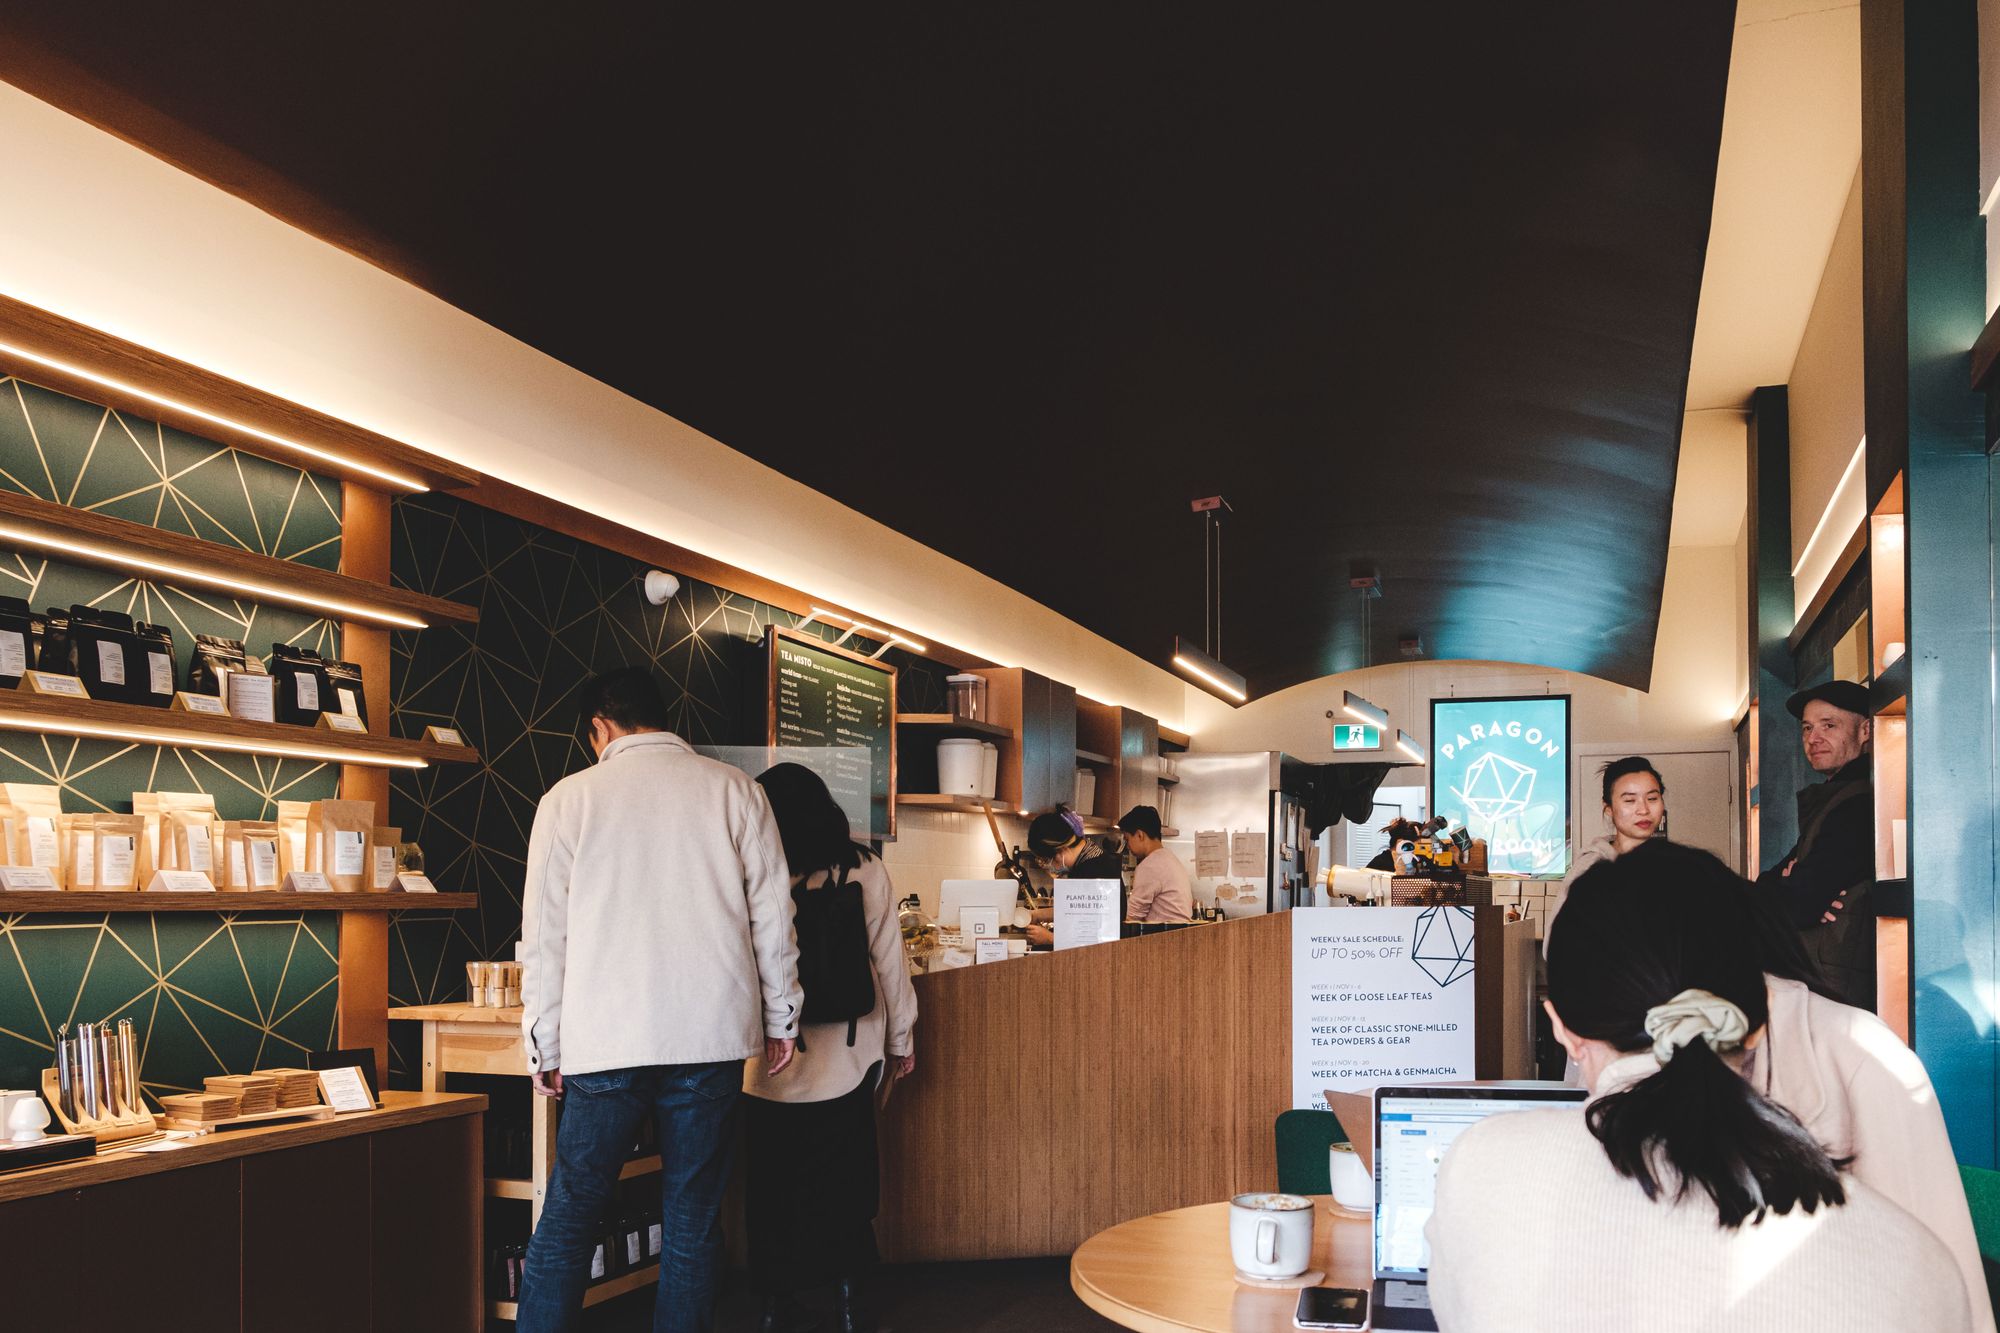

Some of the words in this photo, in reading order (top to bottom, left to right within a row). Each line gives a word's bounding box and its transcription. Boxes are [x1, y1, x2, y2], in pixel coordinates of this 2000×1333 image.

[781, 650, 792, 661] TEA
[793, 654, 812, 667] MISTO
[1440, 720, 1559, 760] PARAGON
[1493, 839, 1552, 854] ROOM
[1363, 935, 1404, 943] SCHEDULE:
[1311, 947, 1328, 959] UP
[1332, 947, 1348, 959] TO
[1351, 950, 1376, 960] 50%
[1379, 947, 1404, 958] OFF
[1312, 994, 1337, 1002] WEEK
[1354, 993, 1384, 1001] LOOSE
[1387, 993, 1409, 1001] LEAF
[1355, 1025, 1391, 1033] CLASSIC
[1394, 1024, 1458, 1032] STONE-MILLED
[1331, 1037, 1375, 1045] POWDERS
[1312, 1070, 1337, 1078] WEEK
[1355, 1069, 1392, 1077] MATCHA
[1395, 1068, 1400, 1076] &
[1403, 1067, 1457, 1075] GENMAICHA
[1312, 1102, 1332, 1110] WEE
